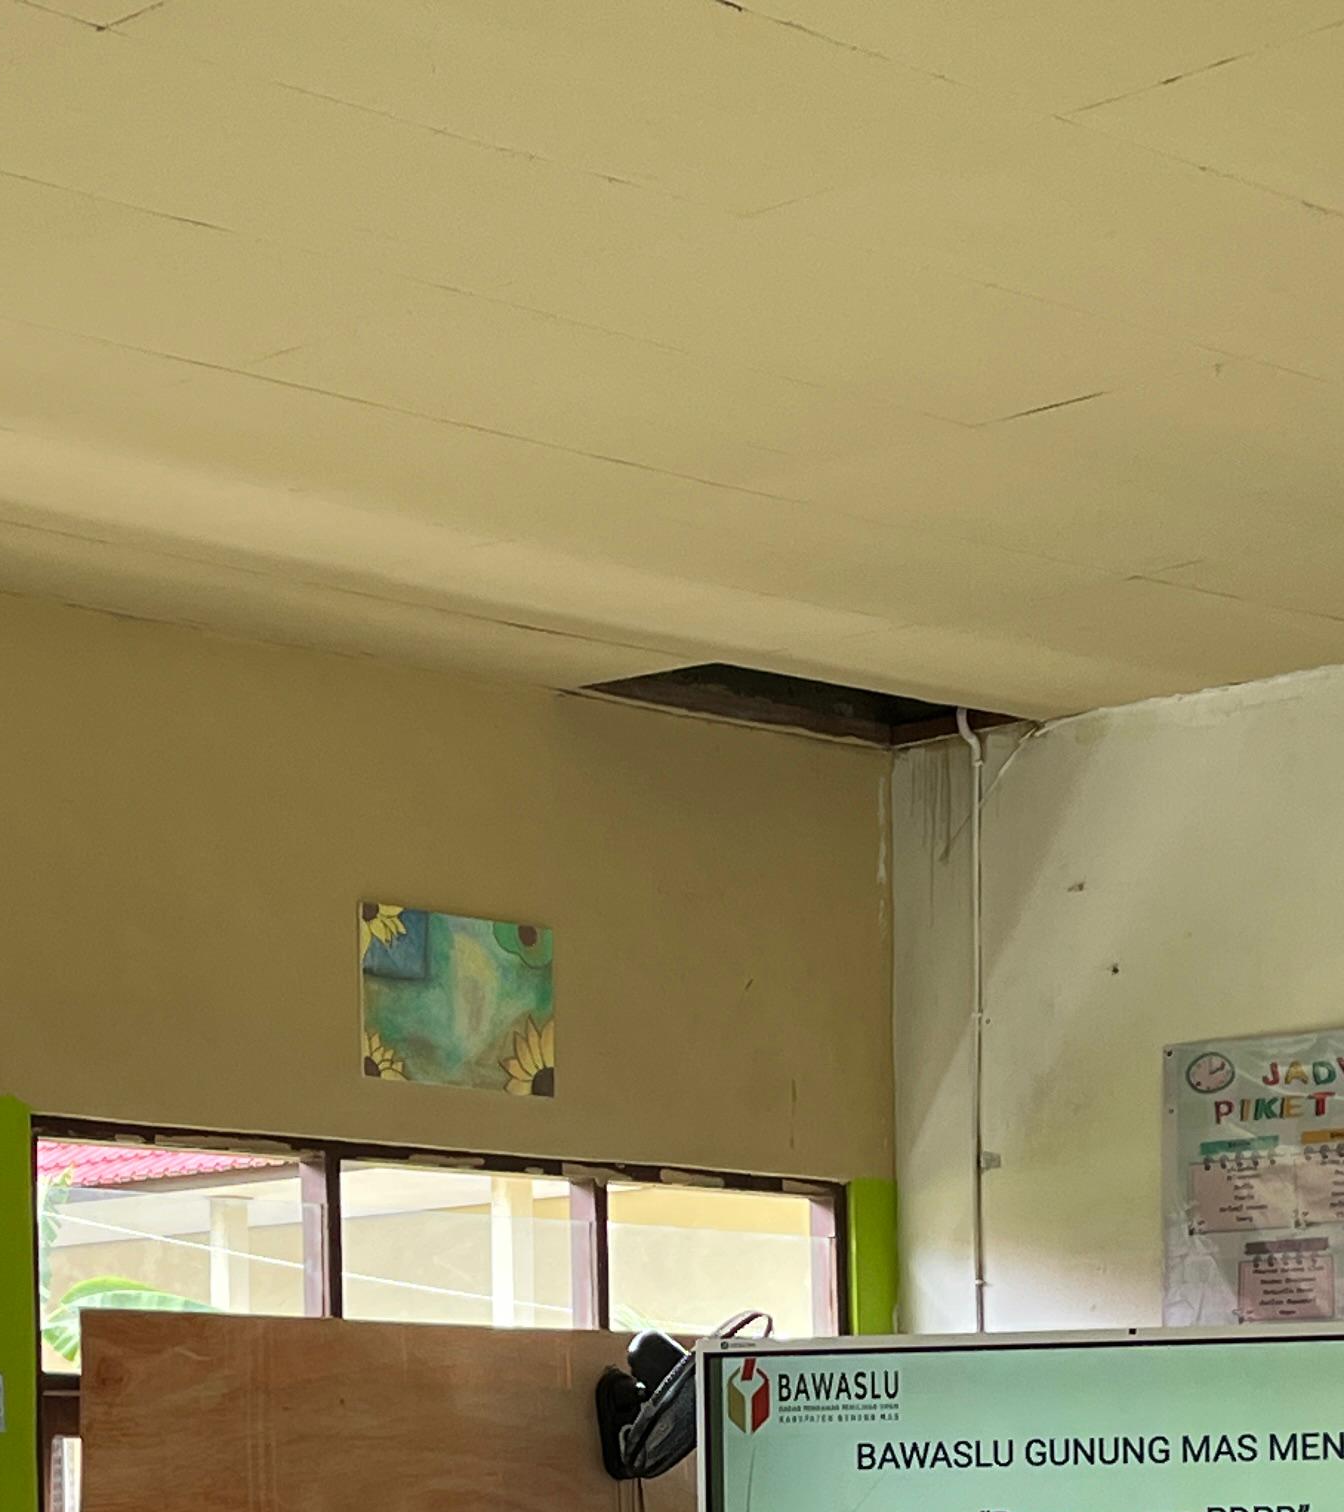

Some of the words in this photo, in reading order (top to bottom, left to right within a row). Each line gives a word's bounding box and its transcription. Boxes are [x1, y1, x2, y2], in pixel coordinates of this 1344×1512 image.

[1214, 1091, 1336, 1124] PIKET
[778, 1370, 899, 1401] BAWASLU
[857, 1440, 1014, 1470] BAWASLU
[1025, 1436, 1171, 1466] GUNUNG
[1182, 1433, 1258, 1463] MAS
